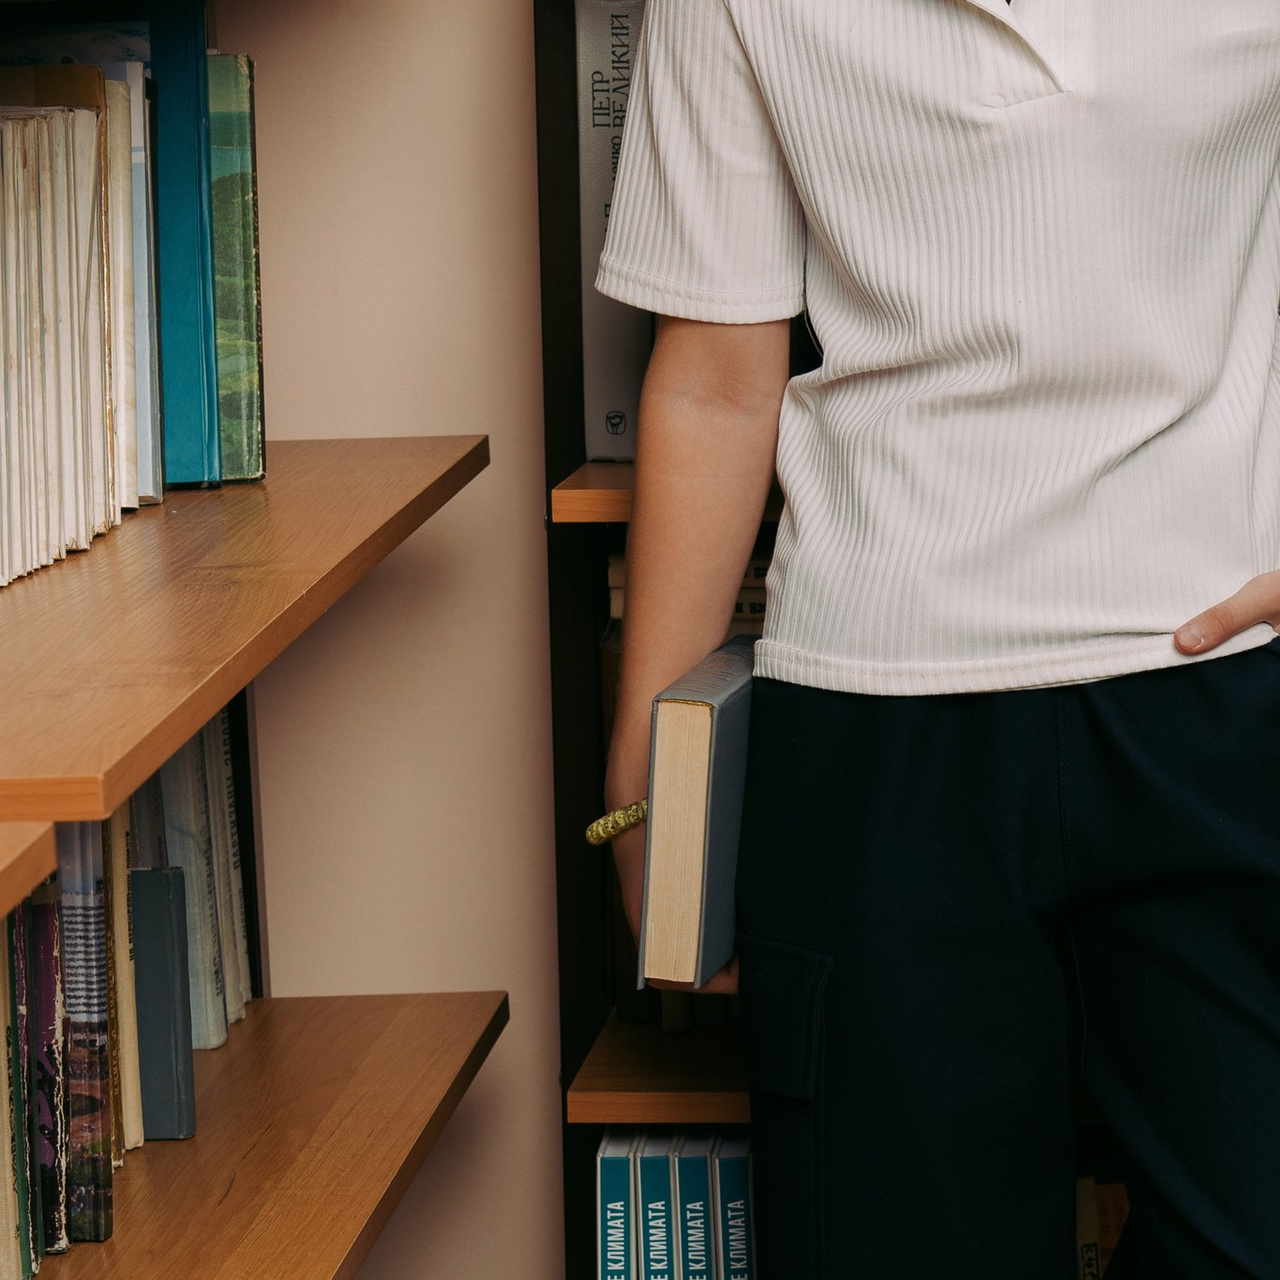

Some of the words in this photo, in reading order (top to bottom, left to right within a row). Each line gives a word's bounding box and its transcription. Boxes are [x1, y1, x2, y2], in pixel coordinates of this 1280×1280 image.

[591, 71, 611, 129] ПЕТР
[611, 14, 630, 129] ВЕЛИКИЙ
[607, 1201, 625, 1270] КЛИМАТА
[649, 1201, 668, 1270] КЛИМАТА
